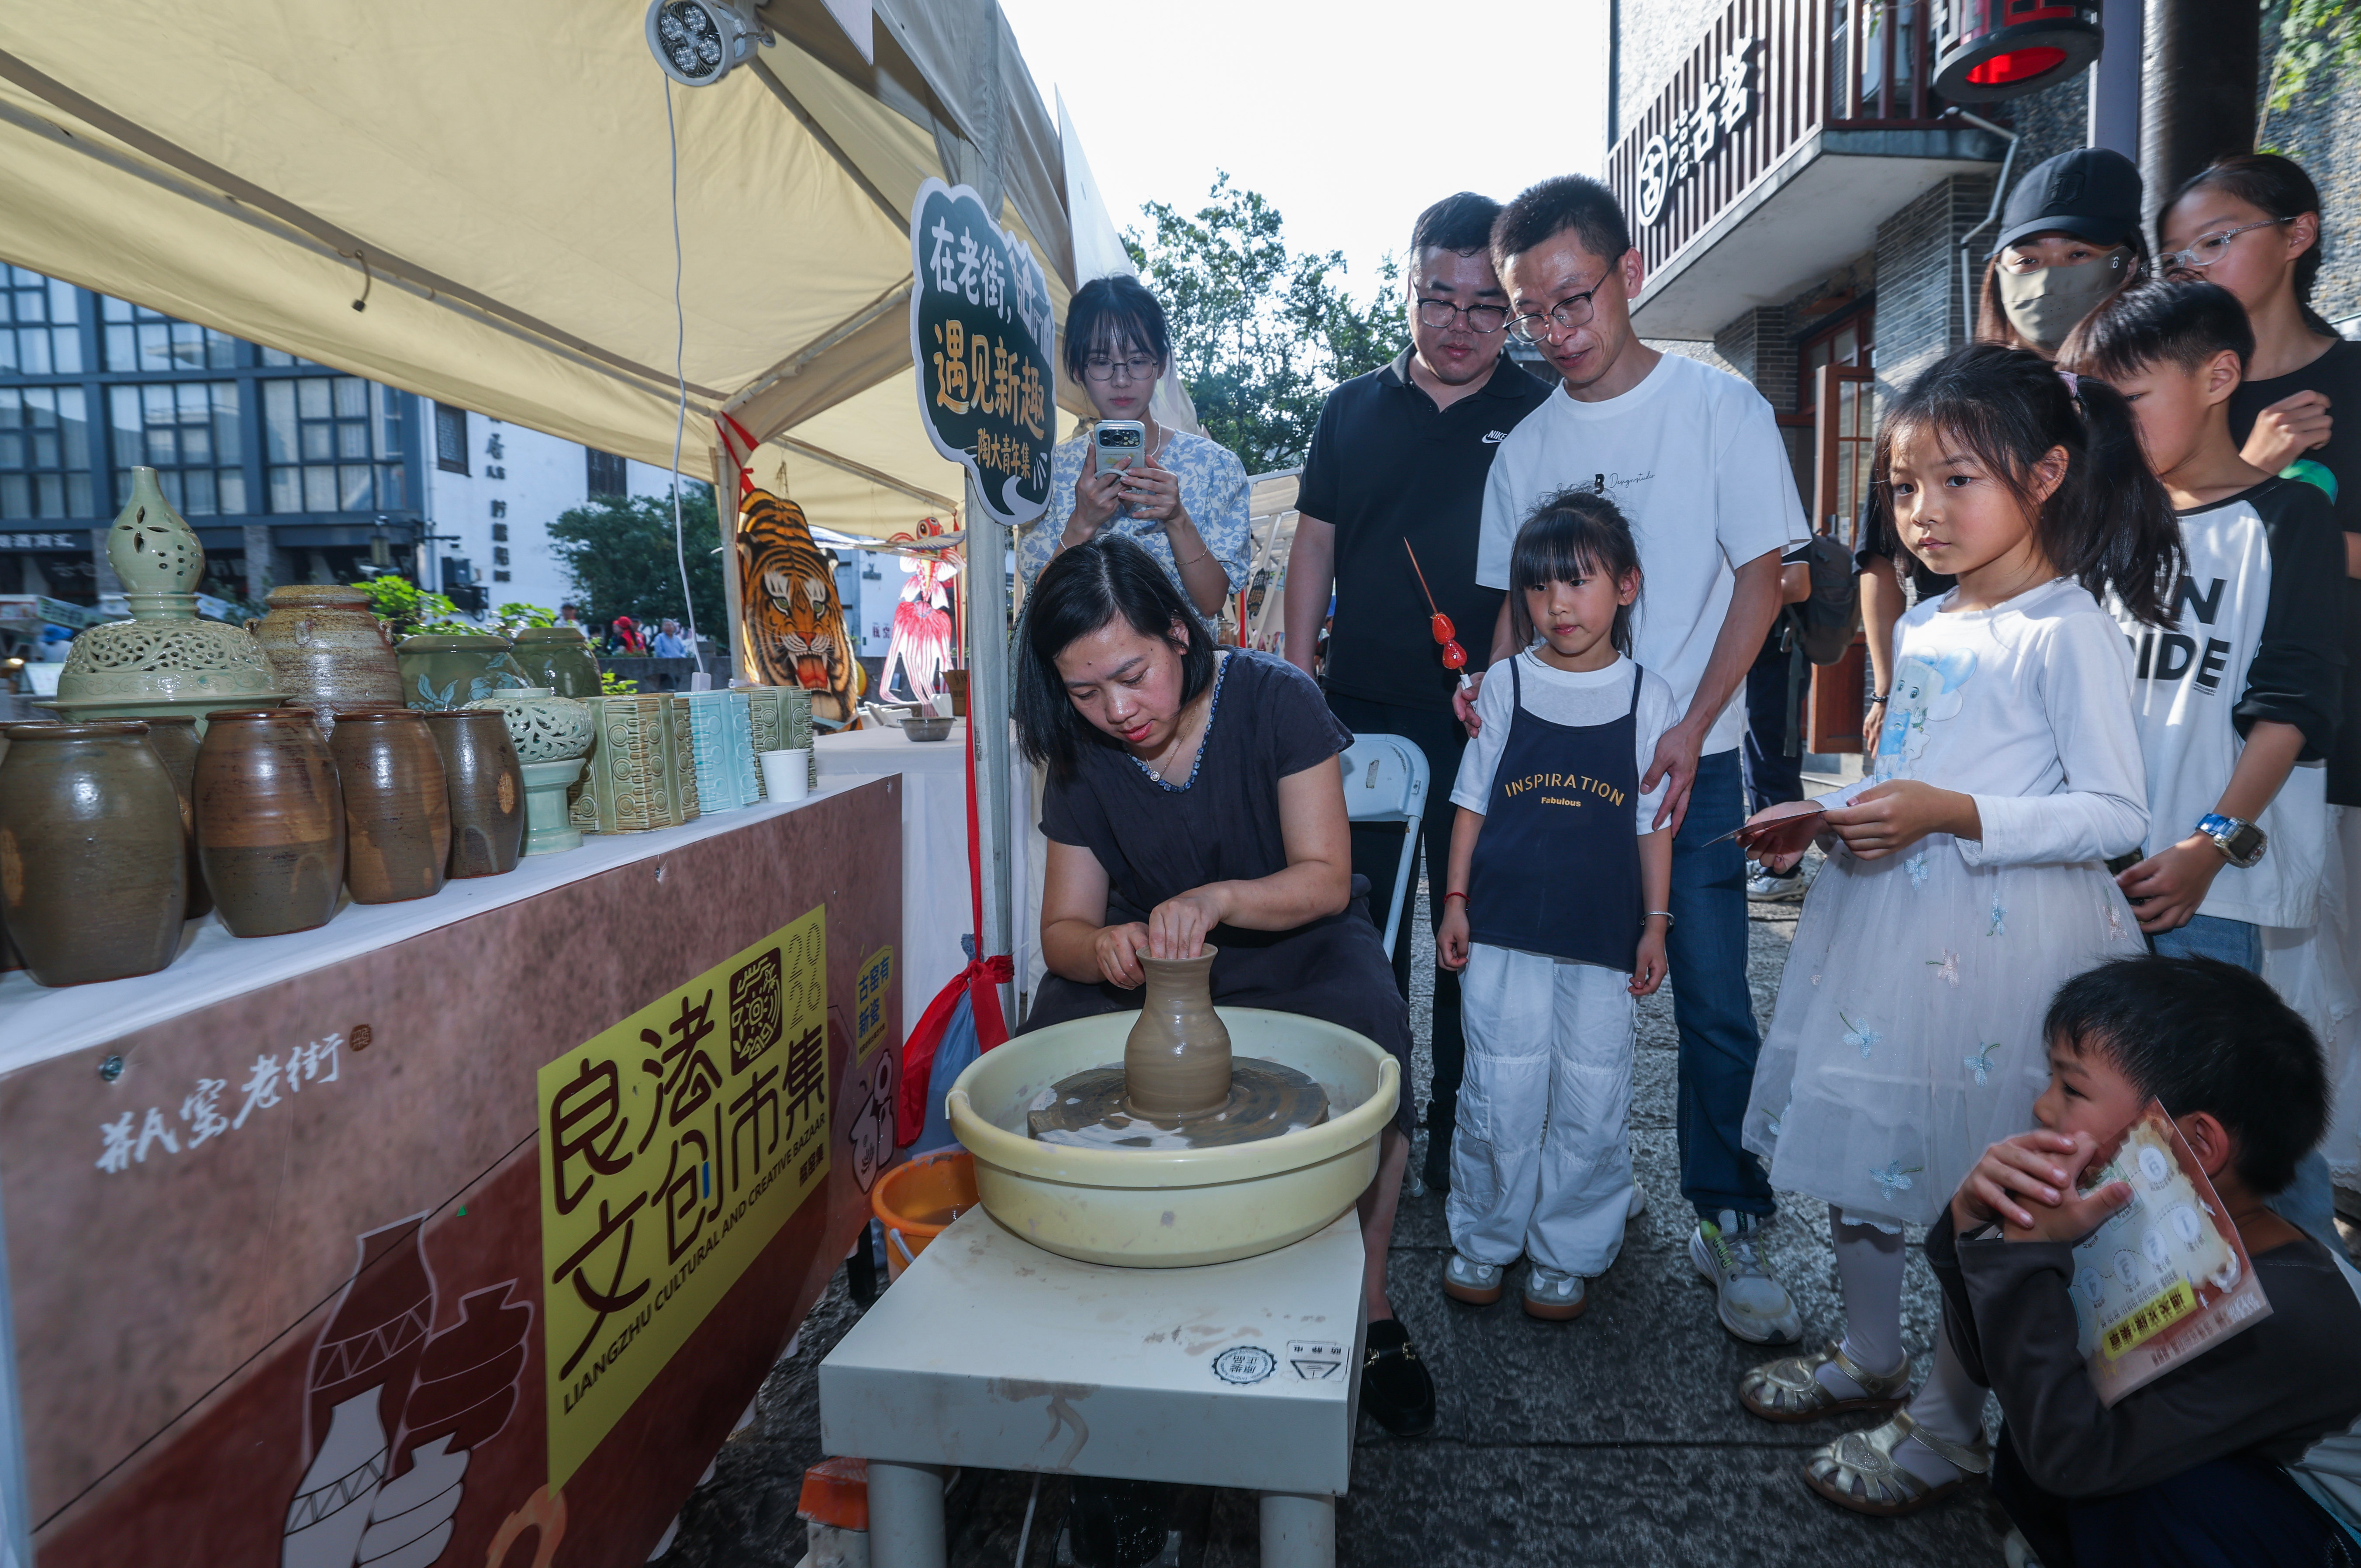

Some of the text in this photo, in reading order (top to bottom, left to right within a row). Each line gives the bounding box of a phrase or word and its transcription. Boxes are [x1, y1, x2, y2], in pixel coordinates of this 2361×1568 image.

[933, 319, 1045, 440] 遇见新趣
[977, 428, 1031, 480] 陶大青年集
[1488, 430, 1507, 441] NIKE
[2128, 633, 2232, 689] IDE
[1505, 773, 1625, 806] INSPIRATION
[1541, 797, 1581, 807] Fabulous
[858, 956, 890, 1004] 古窑有
[95, 1033, 344, 1174] 瓶窑老街
[550, 989, 722, 1215] 良渚
[553, 1024, 825, 1381] 文创市集
[564, 1112, 825, 1415] LIANGZHU CULTURAL AND CREATIVE BAZAAR
[1294, 1345, 1341, 1355] 防静电
